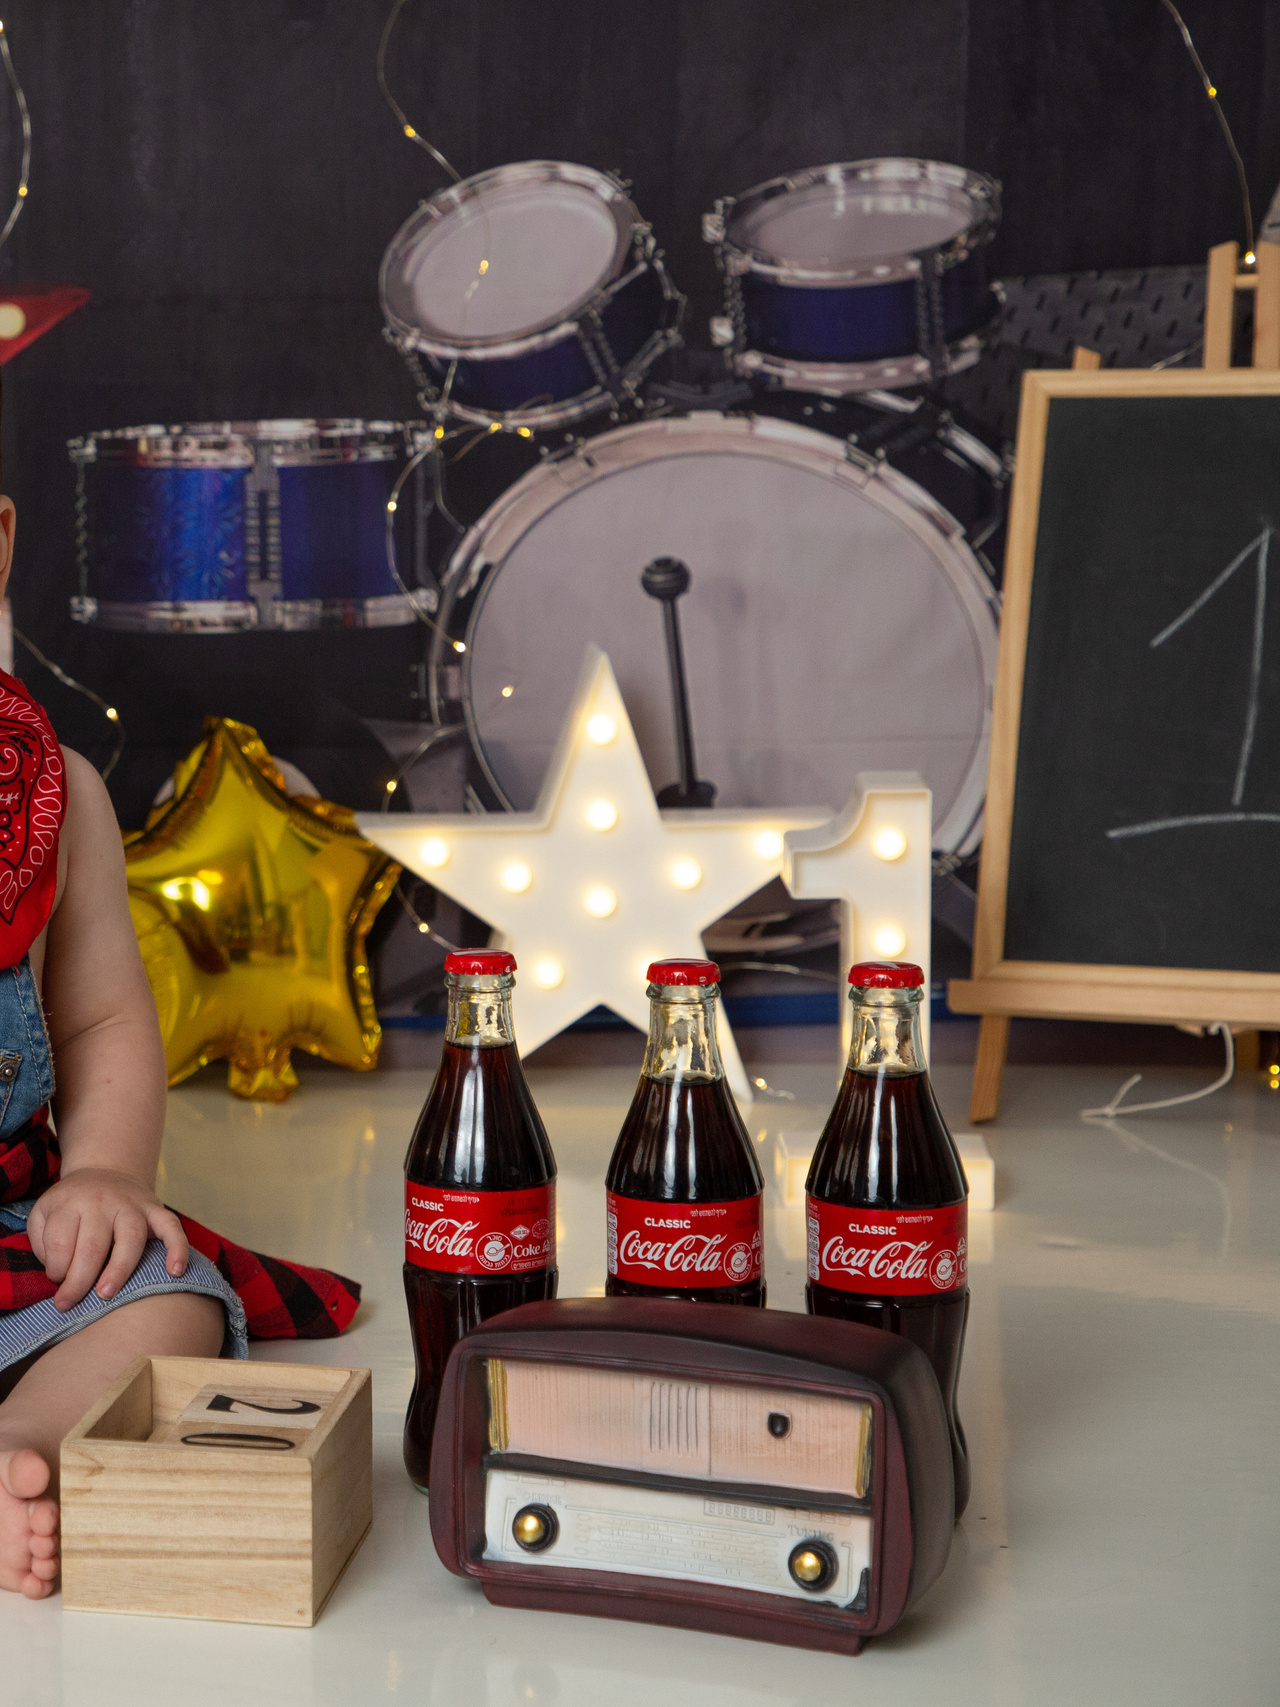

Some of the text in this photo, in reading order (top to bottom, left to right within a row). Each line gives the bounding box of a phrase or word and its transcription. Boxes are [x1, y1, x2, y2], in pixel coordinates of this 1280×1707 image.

[411, 1197, 445, 1212] CLASSIC
[644, 1217, 691, 1229] CLASSIC
[848, 1223, 897, 1236] CLASSIC
[513, 1244, 541, 1258] Coke
[619, 1229, 728, 1272] Coca-Cola
[822, 1235, 934, 1279] Coca-Cola
